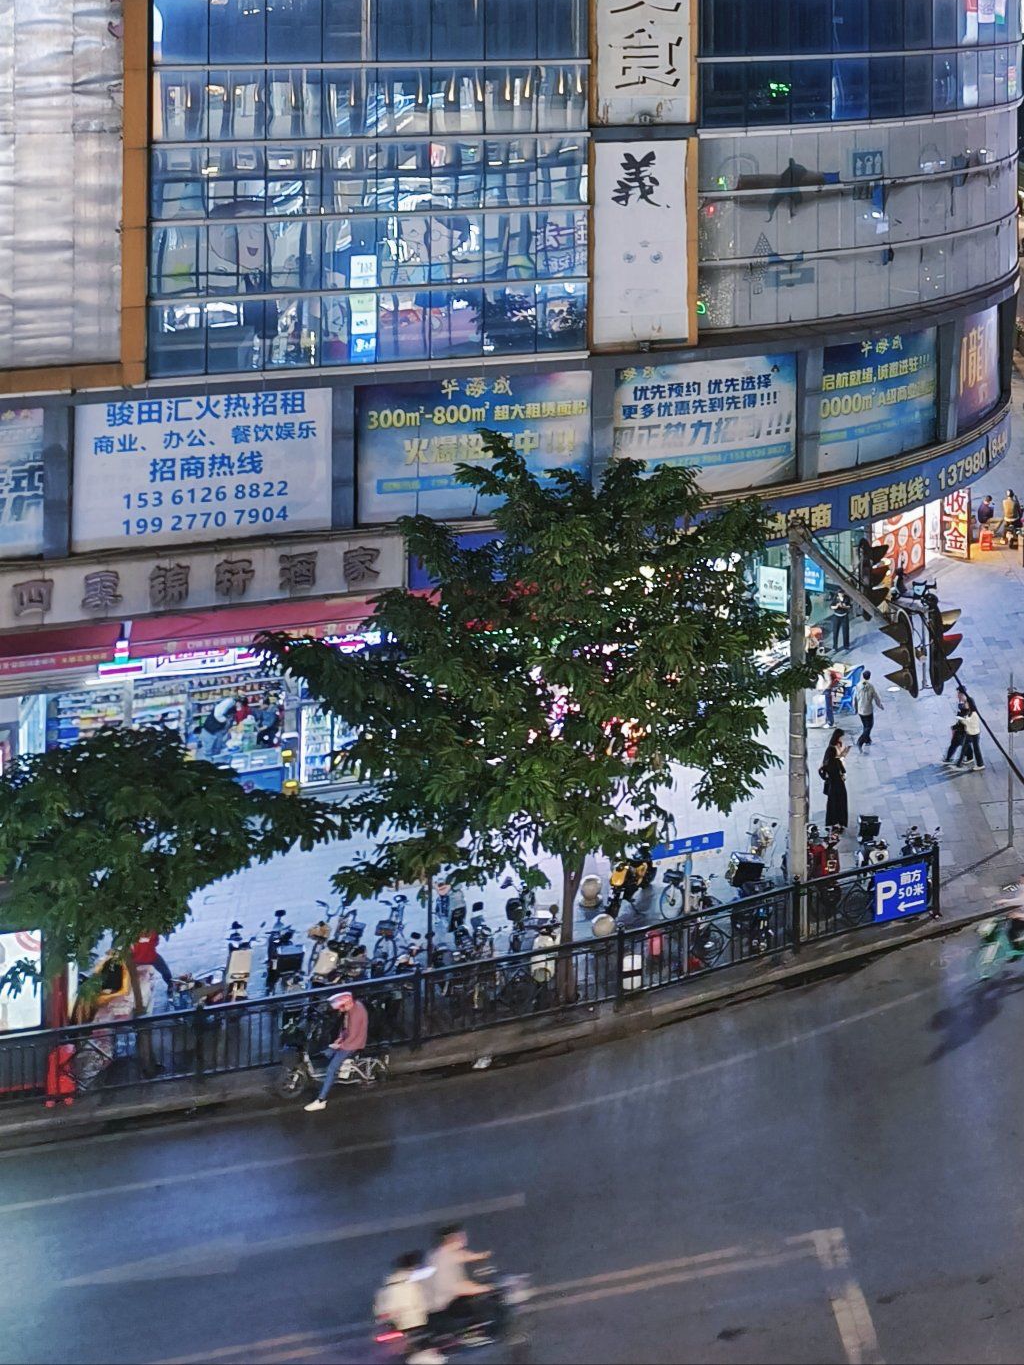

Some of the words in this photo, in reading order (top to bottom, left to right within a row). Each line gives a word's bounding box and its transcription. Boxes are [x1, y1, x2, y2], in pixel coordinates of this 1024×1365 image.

[610, 149, 673, 212] 義
[632, 382, 701, 402] 优先预约
[707, 373, 773, 394] 优先选择
[105, 390, 306, 428] 骏田汇火热招租
[149, 450, 264, 483] 招商热线
[122, 490, 163, 510] 153
[171, 485, 227, 505] 6126
[234, 480, 289, 500] 8822
[121, 516, 163, 536] 199
[170, 510, 227, 532] 2770
[234, 505, 290, 526] 7904
[11, 545, 382, 617] 四季锦轩酒家
[876, 880, 898, 916] P
[898, 882, 925, 900] 50米
